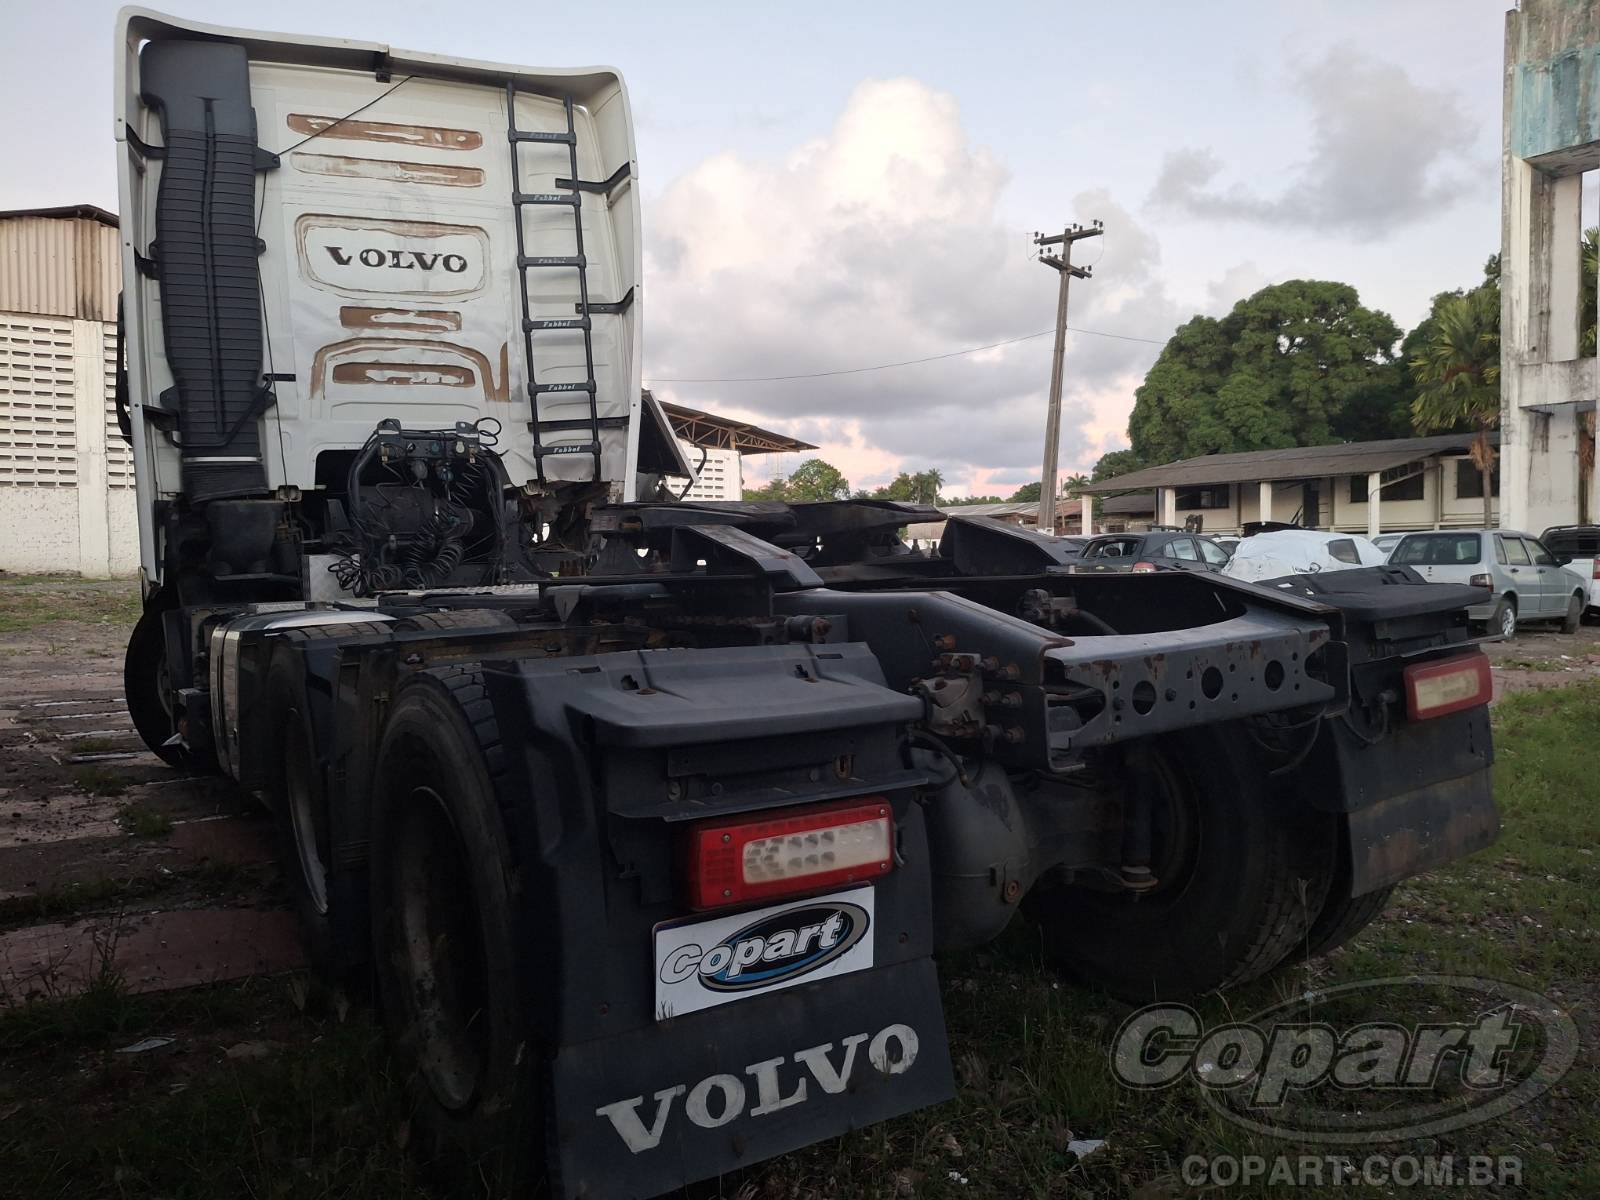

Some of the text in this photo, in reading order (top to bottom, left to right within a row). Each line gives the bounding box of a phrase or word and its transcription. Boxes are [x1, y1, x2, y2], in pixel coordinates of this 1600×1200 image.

[324, 246, 467, 273] VOLVO
[660, 910, 844, 985] Copart
[596, 1023, 919, 1154] VOLVO
